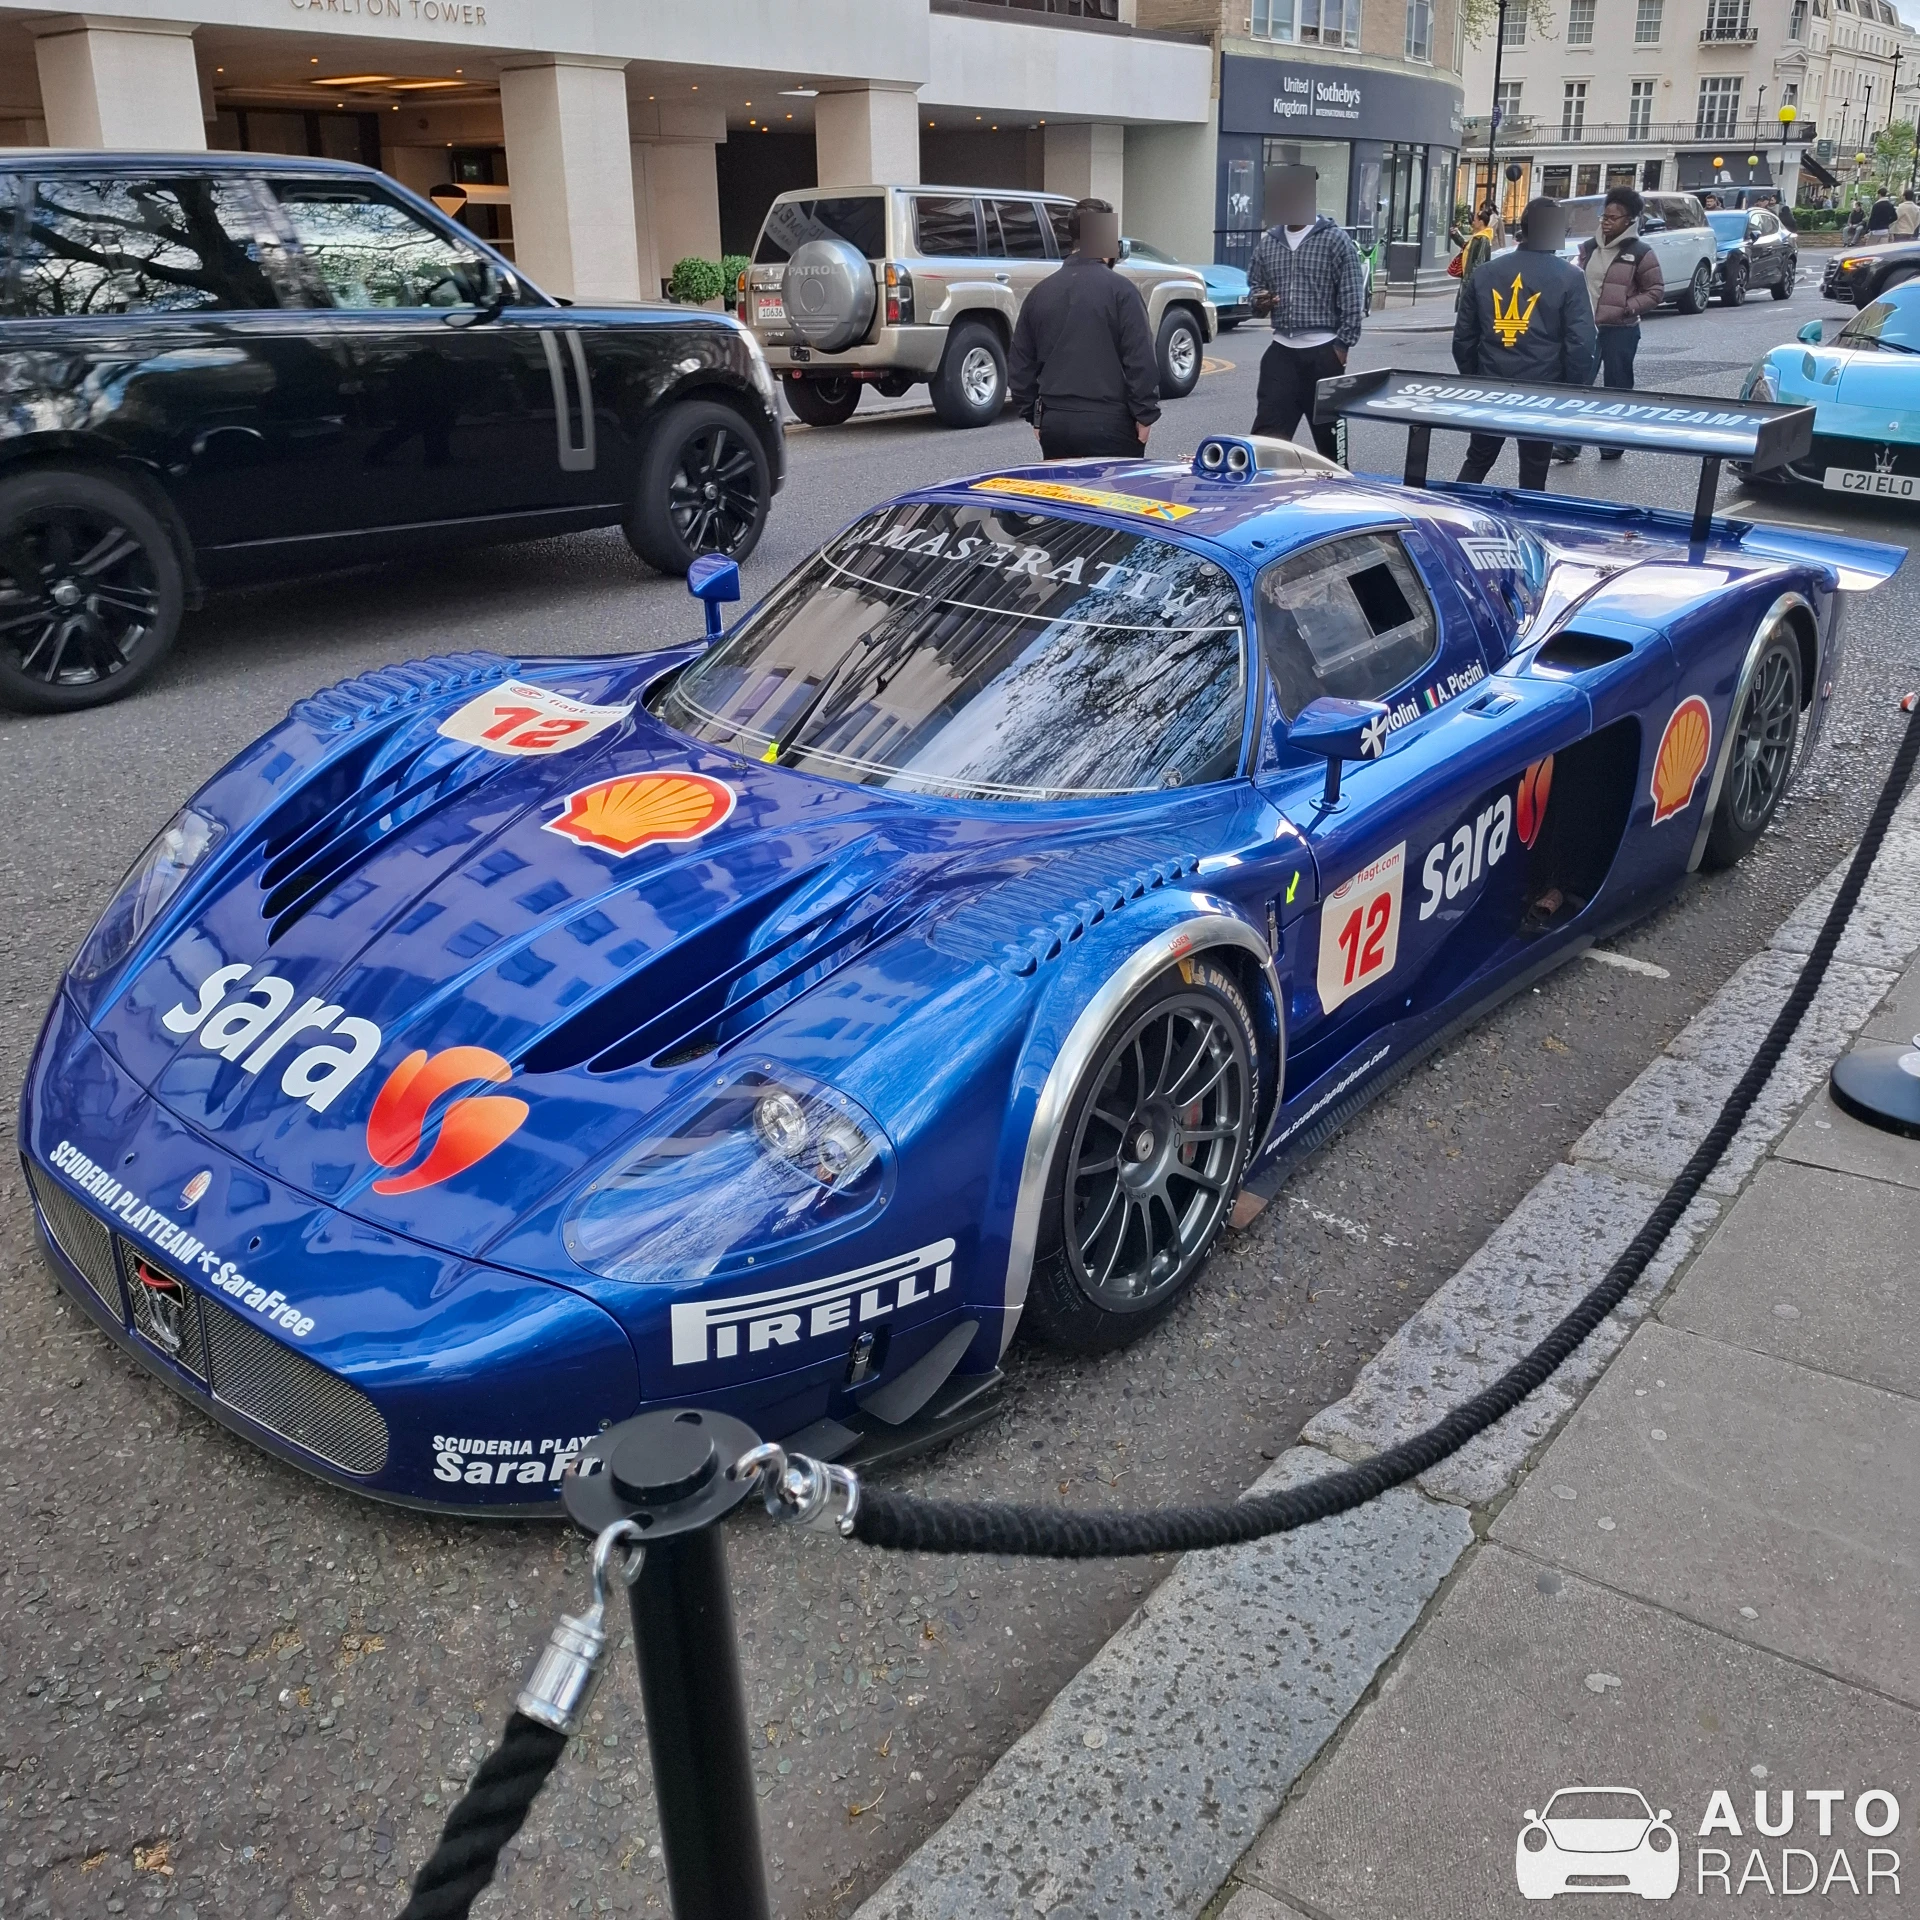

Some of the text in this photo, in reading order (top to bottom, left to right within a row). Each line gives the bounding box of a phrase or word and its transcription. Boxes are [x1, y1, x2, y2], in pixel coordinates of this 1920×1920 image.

[408, 1, 487, 26] TOWER
[1284, 77, 1308, 94] United
[1316, 82, 1361, 108] Sotheby's
[1273, 98, 1308, 118] Kingdom
[788, 265, 841, 276] PATROL
[762, 308, 783, 318] 10636
[1397, 383, 1748, 427] SCUDERIA PLAYTEAM
[1842, 472, 1872, 491] C21
[869, 524, 1161, 600] MASERATI
[1437, 658, 1485, 704] A. Piccini
[547, 699, 623, 718] fiagt.com
[1387, 697, 1421, 733] tolini
[480, 707, 590, 749] 12
[1356, 853, 1400, 885] fiagt.com
[1419, 795, 1512, 921] sara
[1337, 891, 1393, 988] 12
[1208, 969, 1257, 1057] MICHELIN
[162, 963, 382, 1114] sara
[50, 1140, 316, 1338] SCUDERIA PLAYTEAM SaraFree
[671, 1237, 956, 1366] PIRELLI
[432, 1435, 598, 1455] SCUDERIA PLAY
[433, 1450, 606, 1484] SaraFr
